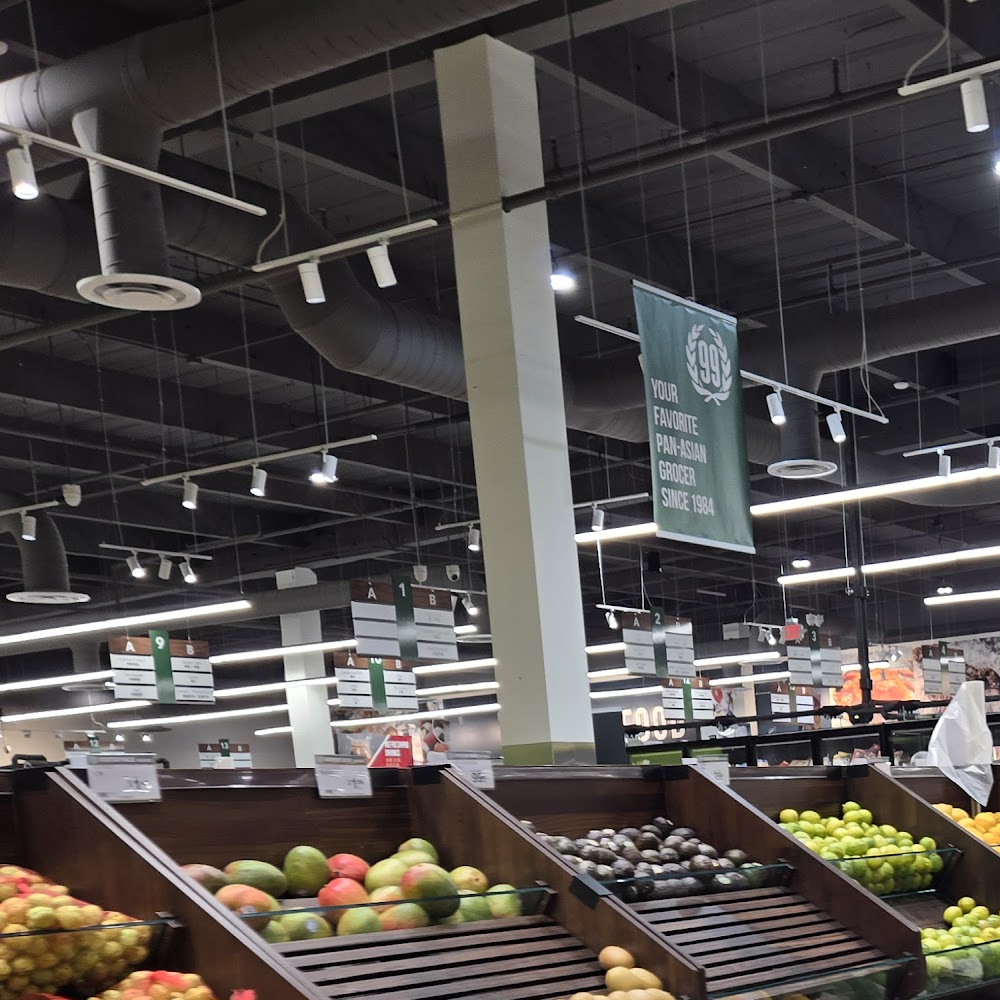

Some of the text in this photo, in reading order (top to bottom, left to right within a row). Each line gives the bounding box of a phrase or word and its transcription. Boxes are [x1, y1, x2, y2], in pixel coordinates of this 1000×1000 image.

[698, 340, 721, 388] 99
[651, 378, 679, 404] YOUR
[653, 405, 699, 436] FAVORITE
[655, 433, 707, 464] PAN-ASIAN
[659, 460, 696, 487] GROCER
[661, 487, 715, 516] SINCE 1984
[367, 582, 437, 605] A 1 B
[633, 617, 640, 627] A
[654, 613, 661, 625] 2
[125, 636, 195, 655] A 9 B
[811, 630, 817, 642] 3
[346, 656, 355, 667] A
[395, 659, 402, 669] B
[668, 679, 674, 687] A
[90, 739, 99, 748] 12
[220, 741, 229, 750] 13
